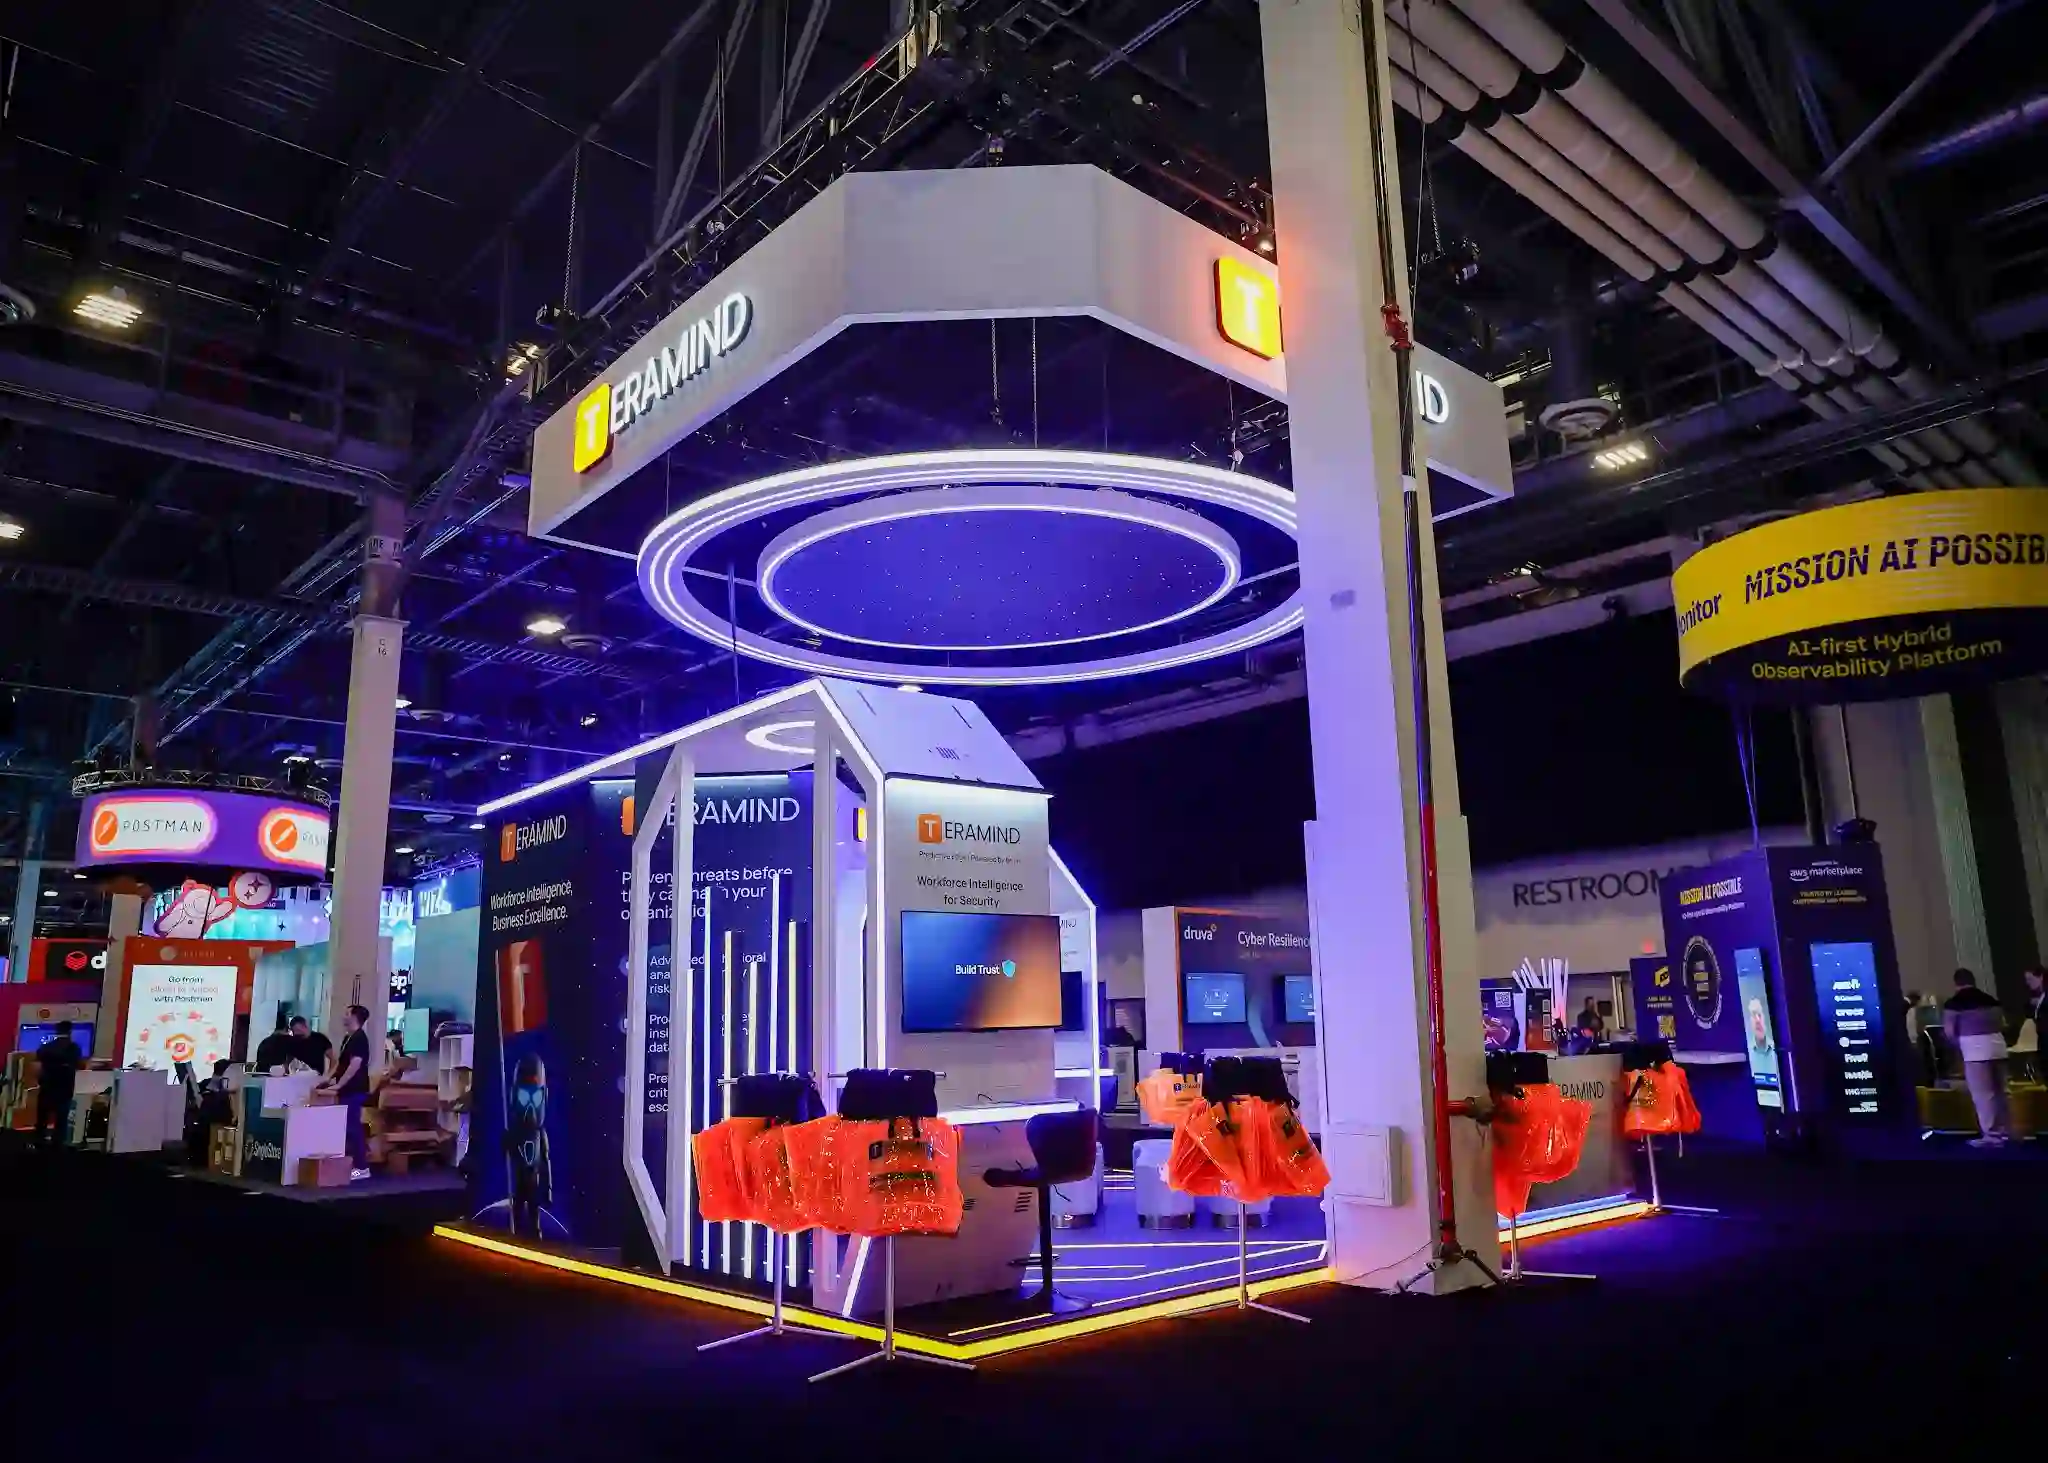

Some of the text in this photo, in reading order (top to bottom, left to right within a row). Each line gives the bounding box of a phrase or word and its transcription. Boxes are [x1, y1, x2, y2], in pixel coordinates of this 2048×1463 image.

[583, 291, 753, 451] TERAMIND
[1744, 533, 2048, 604] MISSION AI POSSIB
[1679, 593, 1722, 635] onitor
[1788, 621, 1952, 656] AI-first Hybrid
[1752, 639, 2003, 680] Observability Platform
[122, 819, 203, 833] POSTMAN
[505, 814, 567, 853] TERAMIND
[924, 820, 1021, 844] TERAMIND
[1809, 865, 1863, 876] marketplace
[731, 885, 767, 902] your
[917, 875, 1024, 893] Workforce Intelligence
[490, 888, 526, 910] Workforce
[943, 894, 1000, 908] for Security
[492, 904, 569, 931] Business Excellence.
[1184, 925, 1213, 941] druva
[1237, 931, 1310, 948] Cyber Resilienc
[955, 964, 1000, 975] Build Trust
